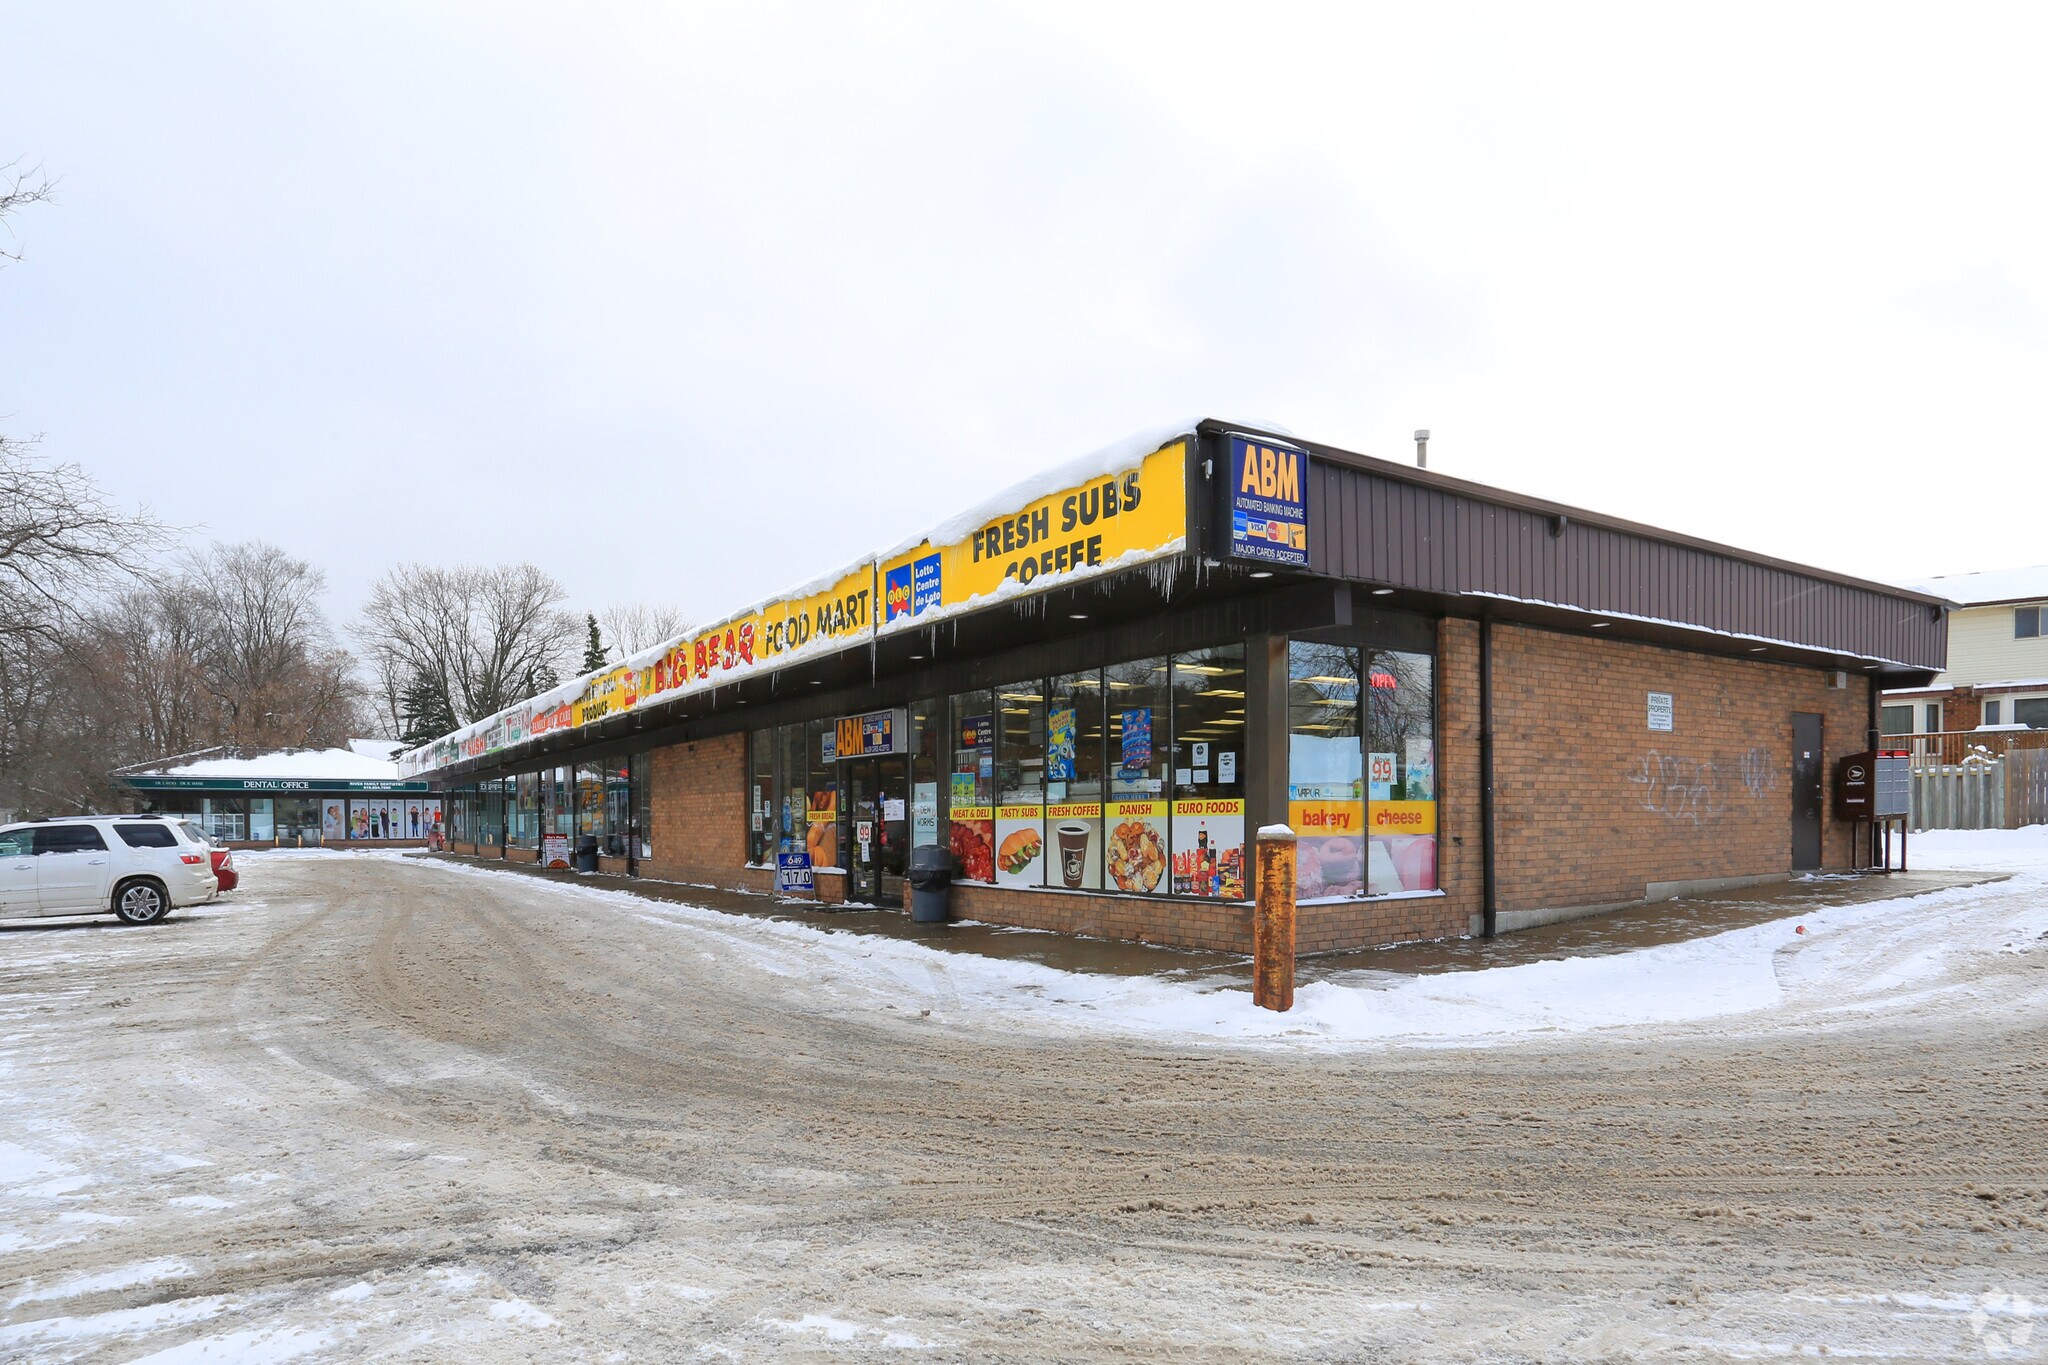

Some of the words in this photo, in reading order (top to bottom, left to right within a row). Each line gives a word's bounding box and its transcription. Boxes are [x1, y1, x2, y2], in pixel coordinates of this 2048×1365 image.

[1241, 444, 1300, 503] ABM
[1236, 497, 1263, 512] AUTOMATED
[1263, 502, 1283, 516] BANKING
[1284, 505, 1304, 519] MACHINE
[972, 506, 1049, 563] FRESH
[1061, 472, 1142, 532] SUBS
[1251, 522, 1264, 532] VISA
[1235, 543, 1255, 556] MAJOR
[1256, 546, 1276, 558] CARDS
[1276, 549, 1305, 562] ACCEPTED
[916, 565, 934, 578] Lotto
[916, 578, 940, 592] Centre
[888, 585, 910, 604] OLG
[916, 596, 925, 606] de
[925, 591, 941, 604] Loto
[695, 622, 754, 679] BEAR
[766, 614, 810, 655] FOOD
[816, 589, 869, 637] MART
[1371, 673, 1397, 688] OPEN
[1650, 696, 1669, 705] PRIVATE
[582, 700, 608, 723] PRODUCE
[1649, 705, 1671, 713] PROPERTY
[836, 716, 864, 757] ABM
[467, 735, 487, 757] SUSHI
[1372, 761, 1391, 778] 99
[281, 781, 309, 789] OFFICE
[953, 809, 970, 818] MEAT
[970, 809, 975, 818] &
[976, 808, 990, 817] DELI
[1001, 808, 1020, 817] TASTY
[1021, 807, 1038, 817] SUBS
[1048, 806, 1070, 816] FRESH
[1072, 805, 1099, 816] COFFEE
[1119, 804, 1152, 815] DANISH
[1177, 802, 1203, 814] EURO
[1205, 801, 1239, 813] FOODS
[917, 817, 935, 827] WORMS
[1302, 808, 1350, 828] bakery
[1377, 808, 1422, 824] cheese
[860, 826, 869, 838] 99
